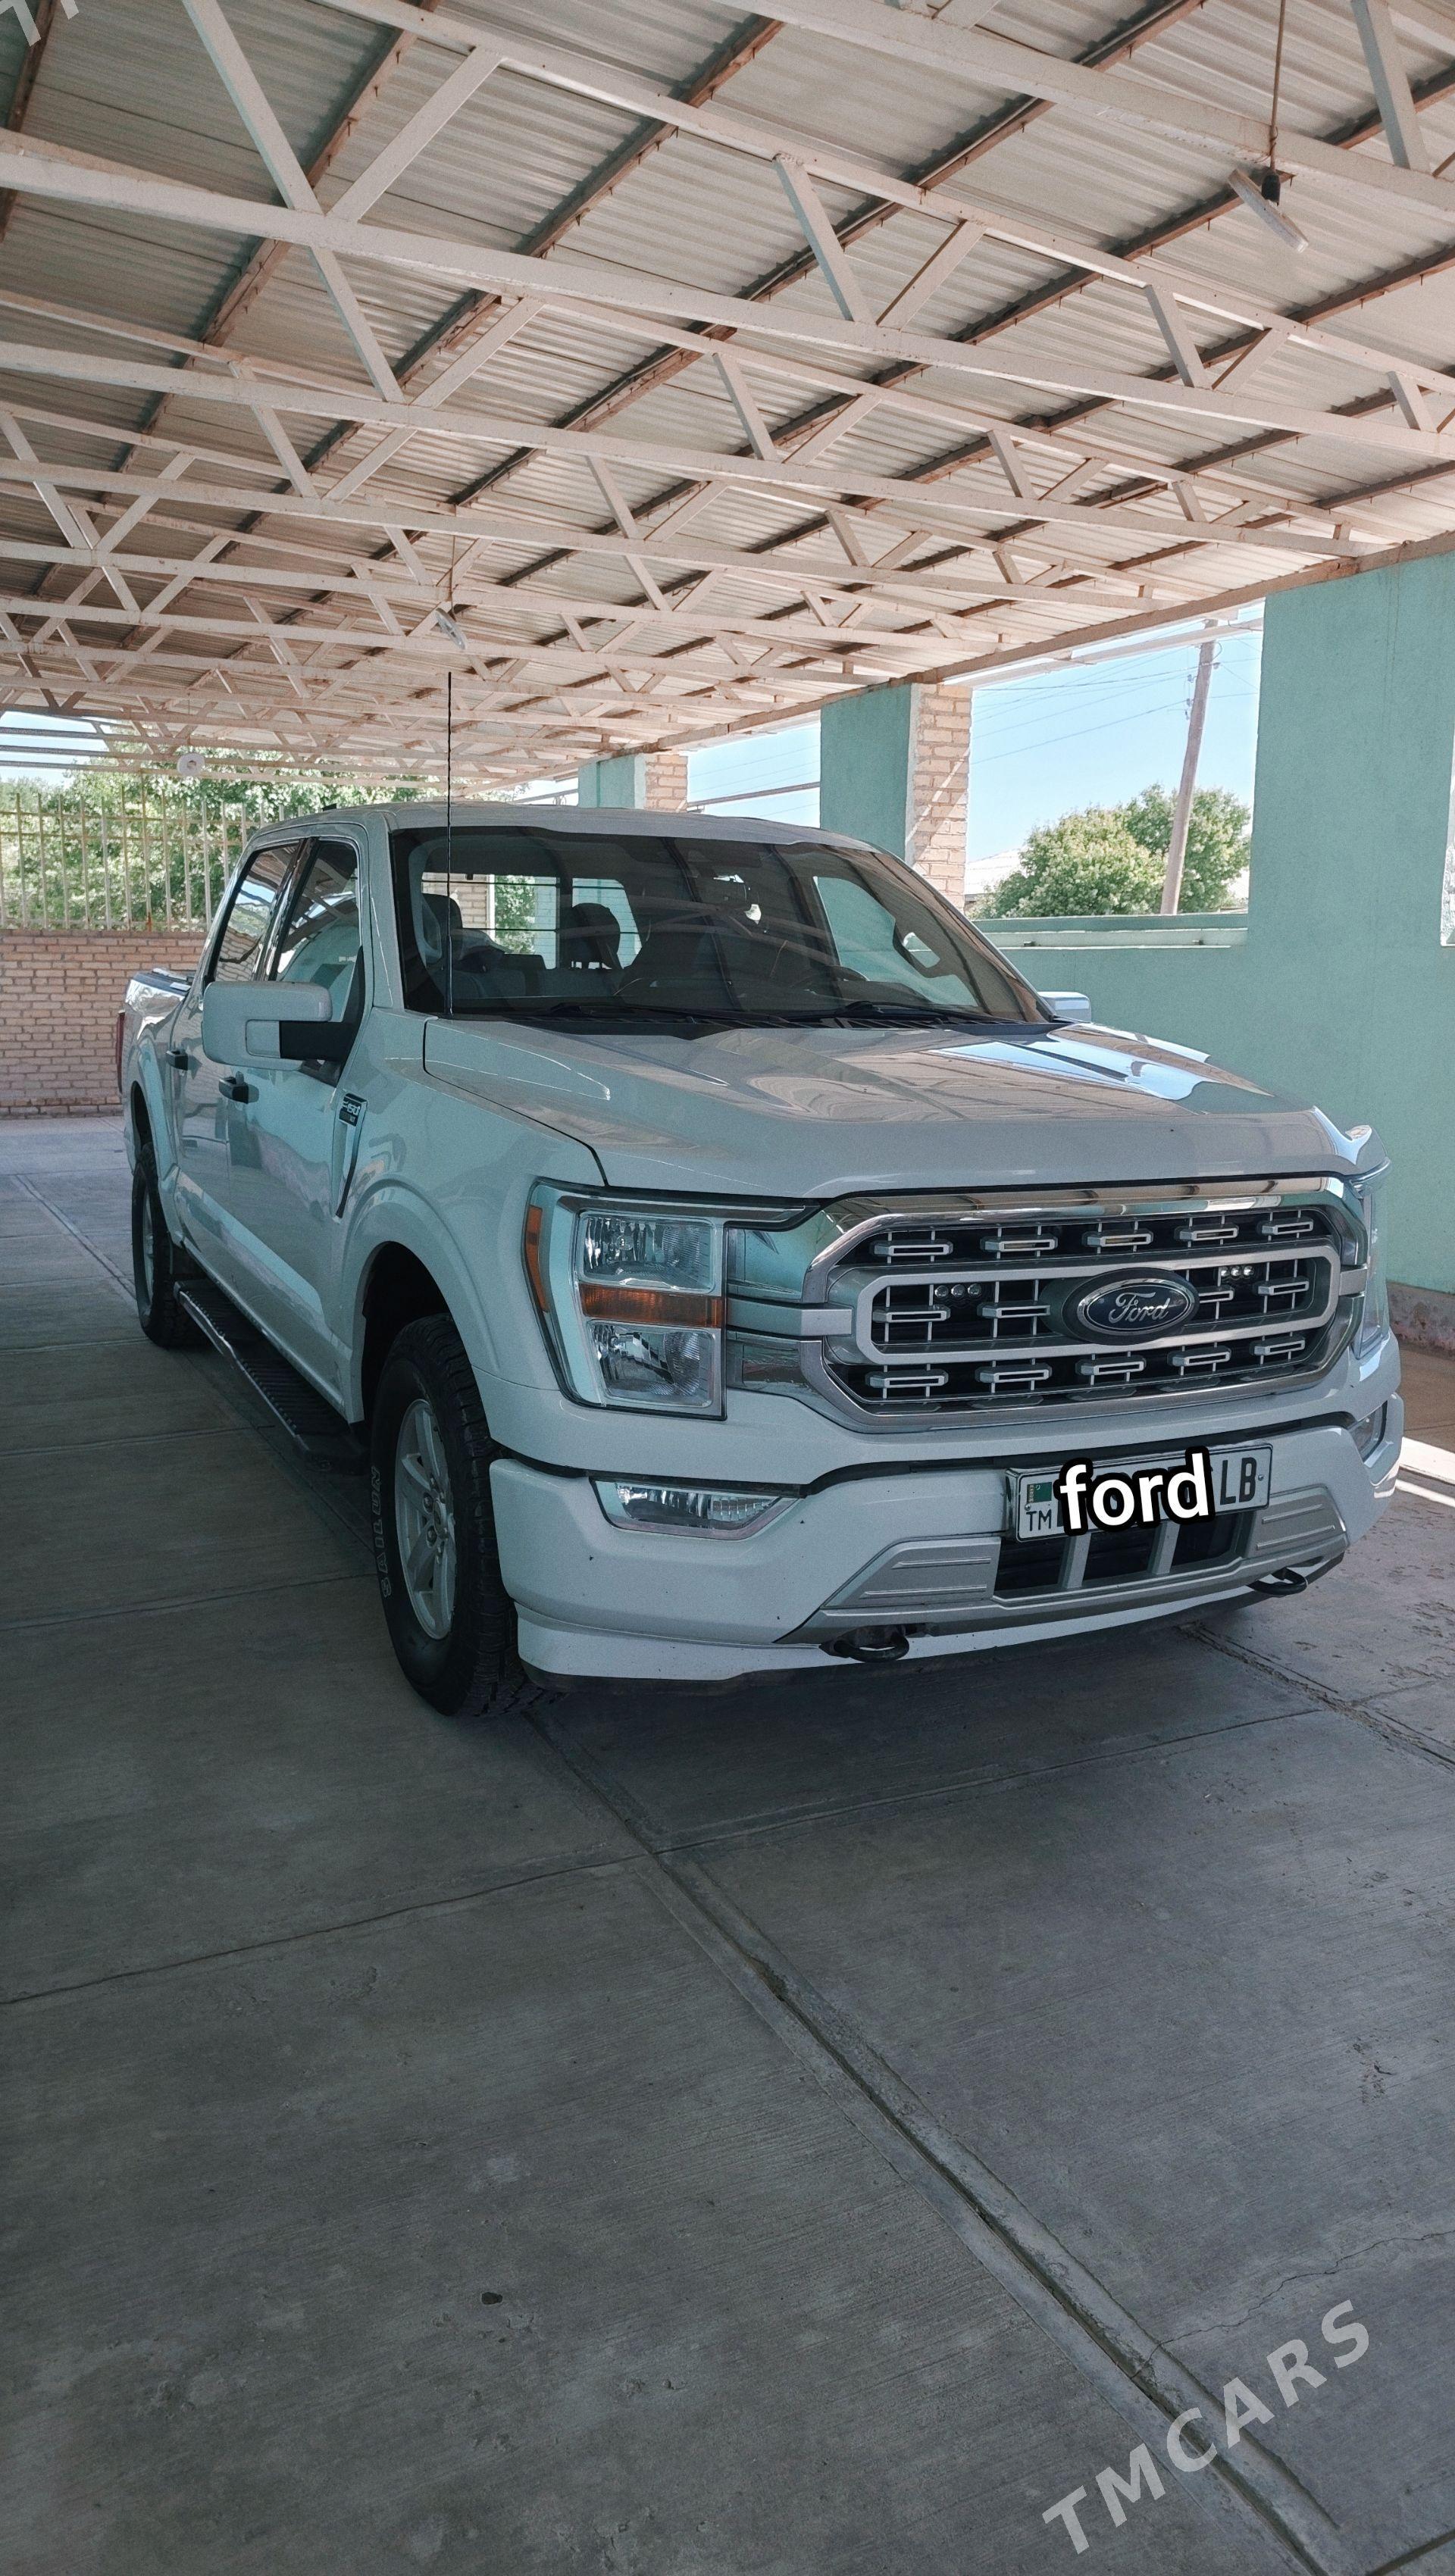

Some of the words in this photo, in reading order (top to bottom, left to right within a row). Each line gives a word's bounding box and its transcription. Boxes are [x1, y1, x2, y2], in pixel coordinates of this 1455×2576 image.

[1108, 1292, 1171, 1324] Ford
[1219, 1456, 1257, 1505] LB
[371, 1465, 392, 1599] SAILUN
[1025, 1508, 1052, 1532] TM
